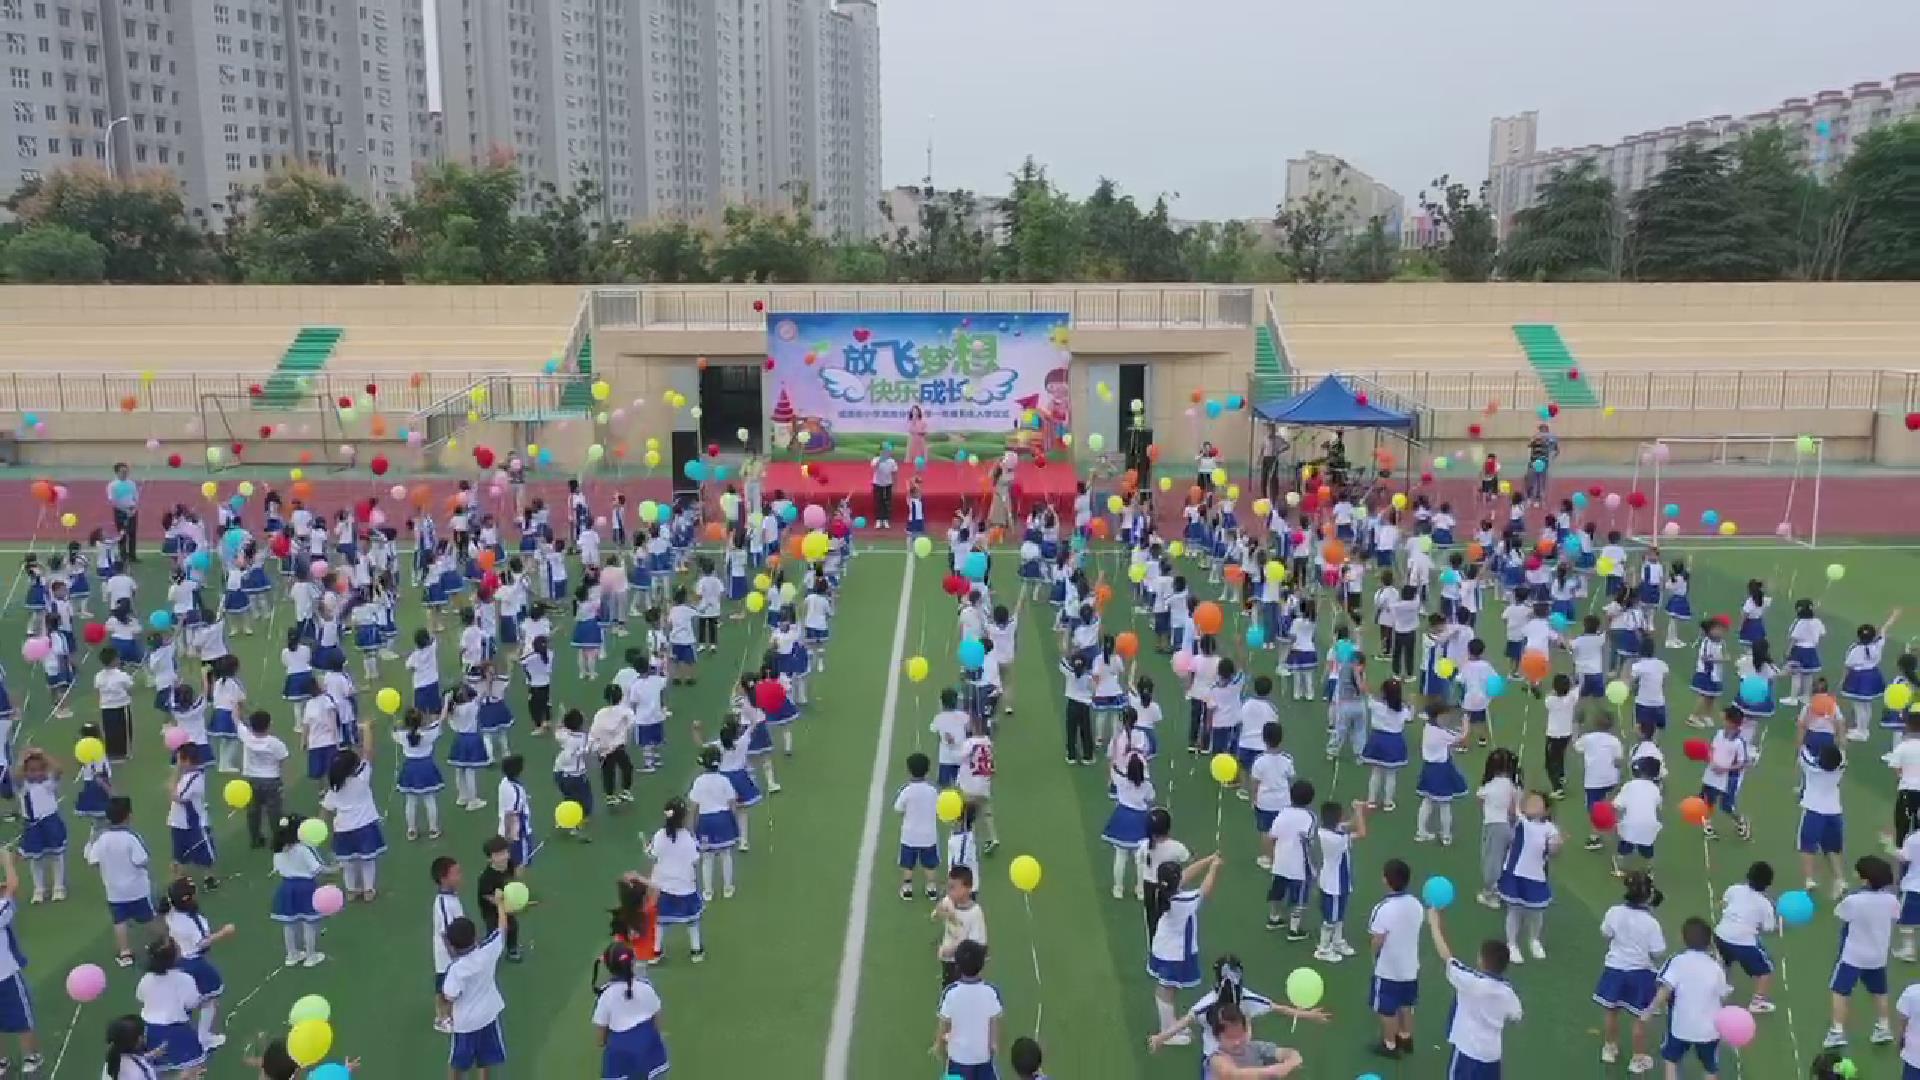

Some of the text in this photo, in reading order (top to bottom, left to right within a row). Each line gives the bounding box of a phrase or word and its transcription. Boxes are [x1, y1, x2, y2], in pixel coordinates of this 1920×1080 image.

[843, 333, 999, 378] 放飞梦想
[867, 378, 971, 404] 快乐成长
